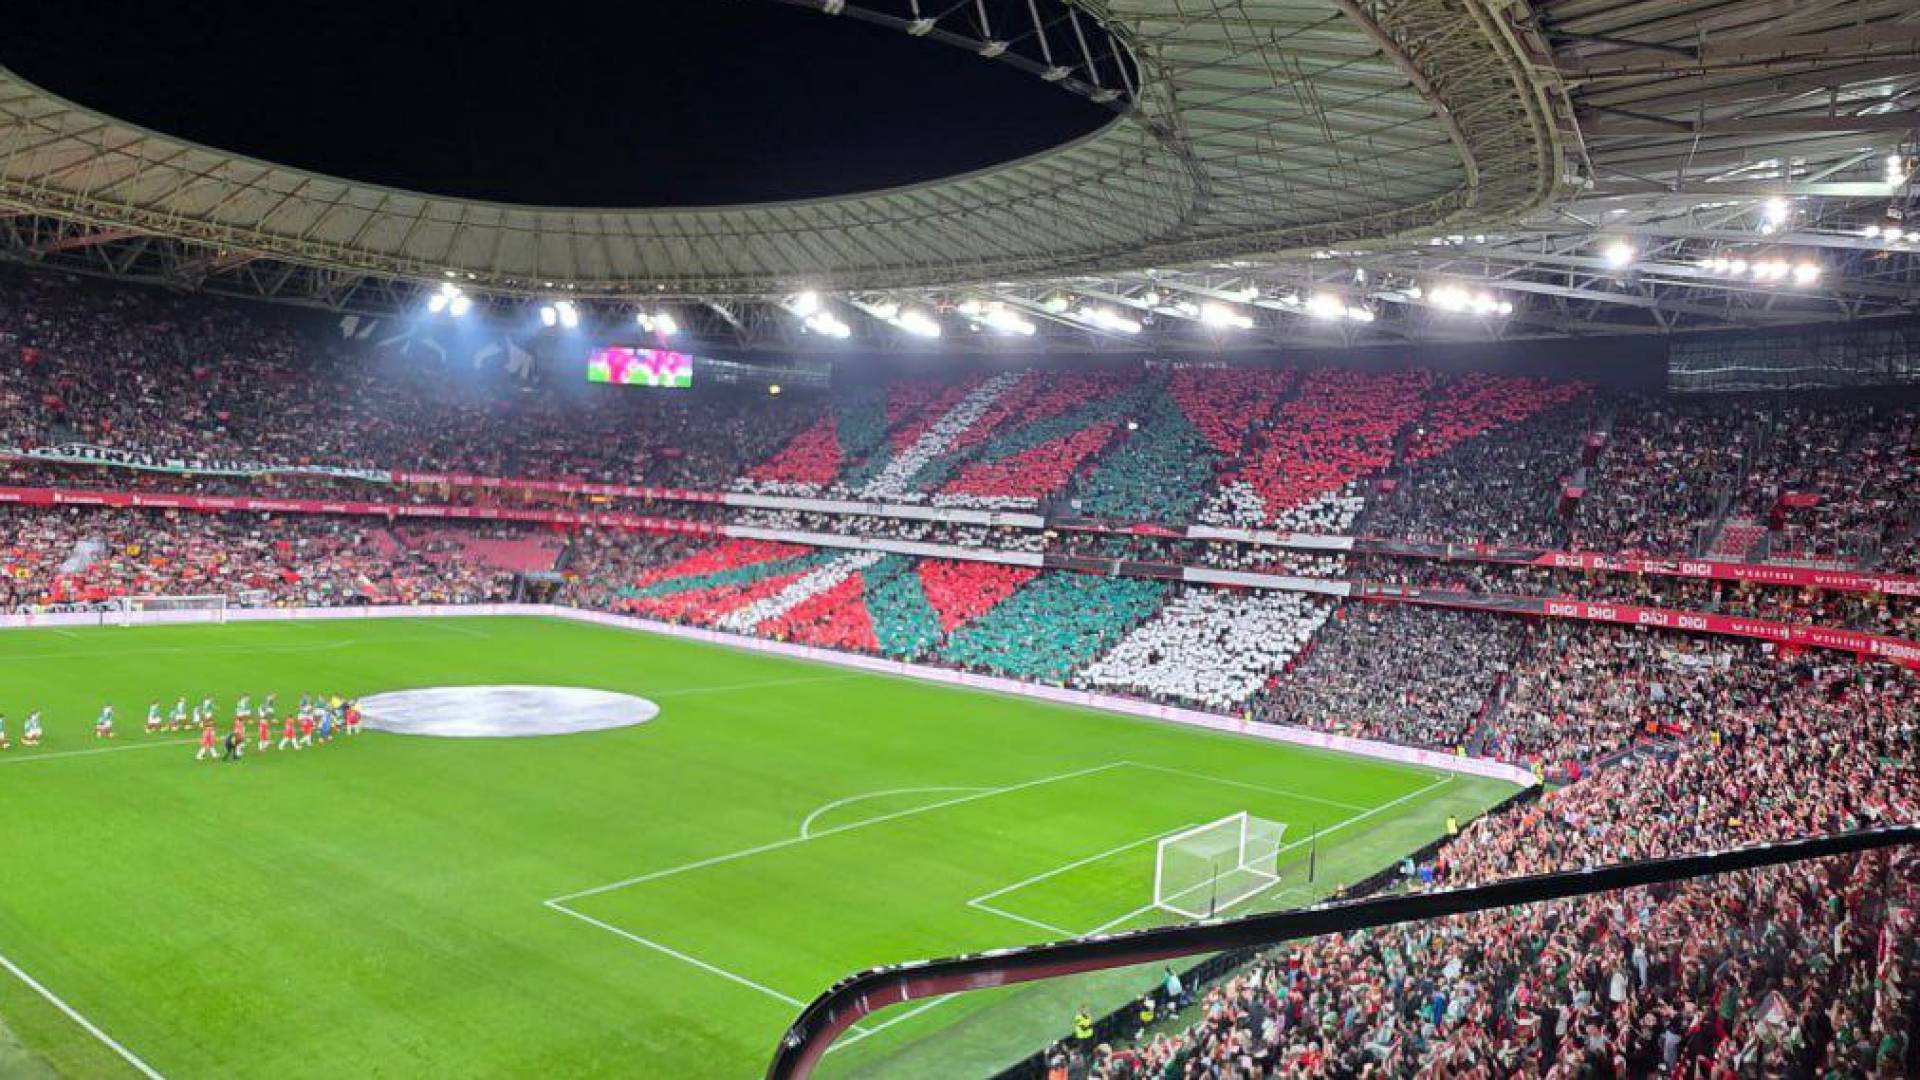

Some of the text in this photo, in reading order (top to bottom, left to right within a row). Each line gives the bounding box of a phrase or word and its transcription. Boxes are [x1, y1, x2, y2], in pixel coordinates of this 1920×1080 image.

[1683, 563, 1711, 576] DIGI
[1550, 603, 1577, 617] DIGI
[1588, 606, 1616, 620] DIGI
[1639, 611, 1668, 625] DIGI
[1679, 616, 1706, 630] DIGI
